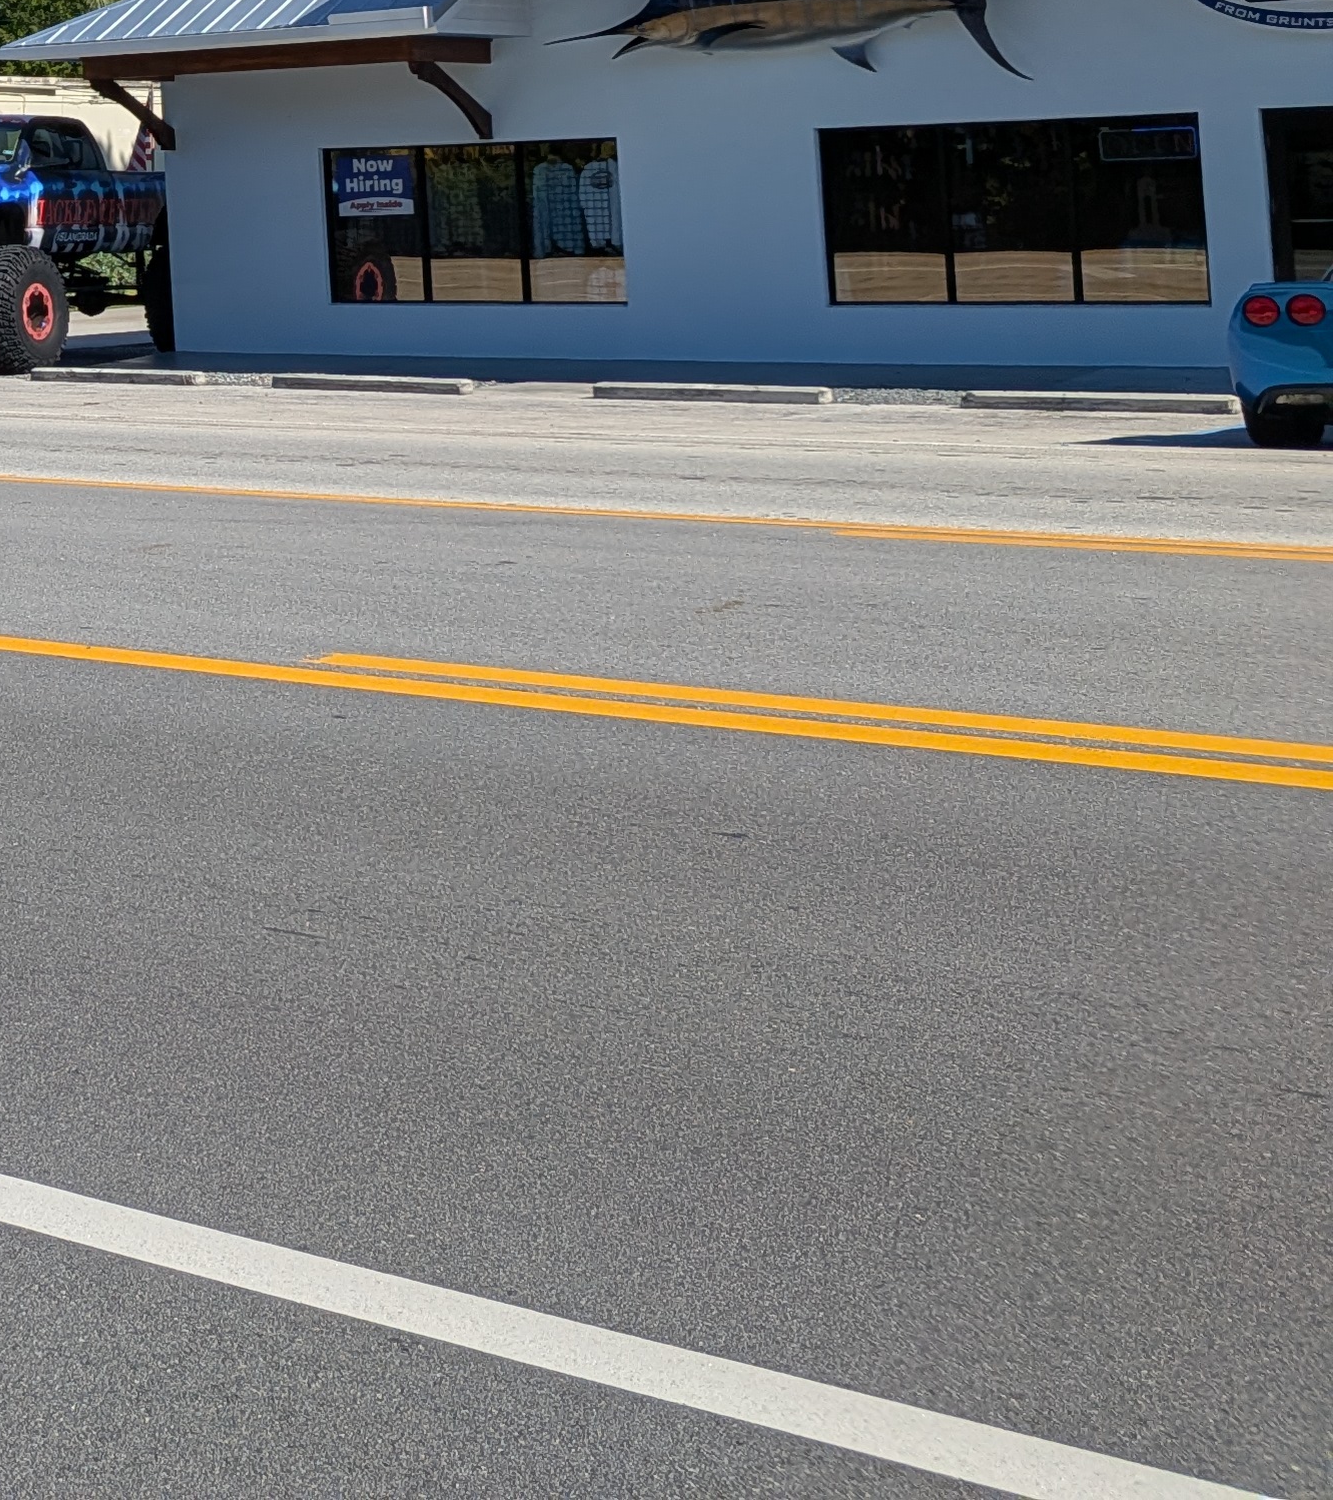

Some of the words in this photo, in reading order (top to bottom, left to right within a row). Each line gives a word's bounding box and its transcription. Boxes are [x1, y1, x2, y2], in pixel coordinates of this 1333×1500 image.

[1215, 2, 1260, 21] FROM
[352, 158, 393, 173] Now
[345, 175, 403, 194] Hiring
[36, 199, 95, 225] TACKLE
[350, 201, 374, 211] Apply
[377, 200, 403, 208] Inside
